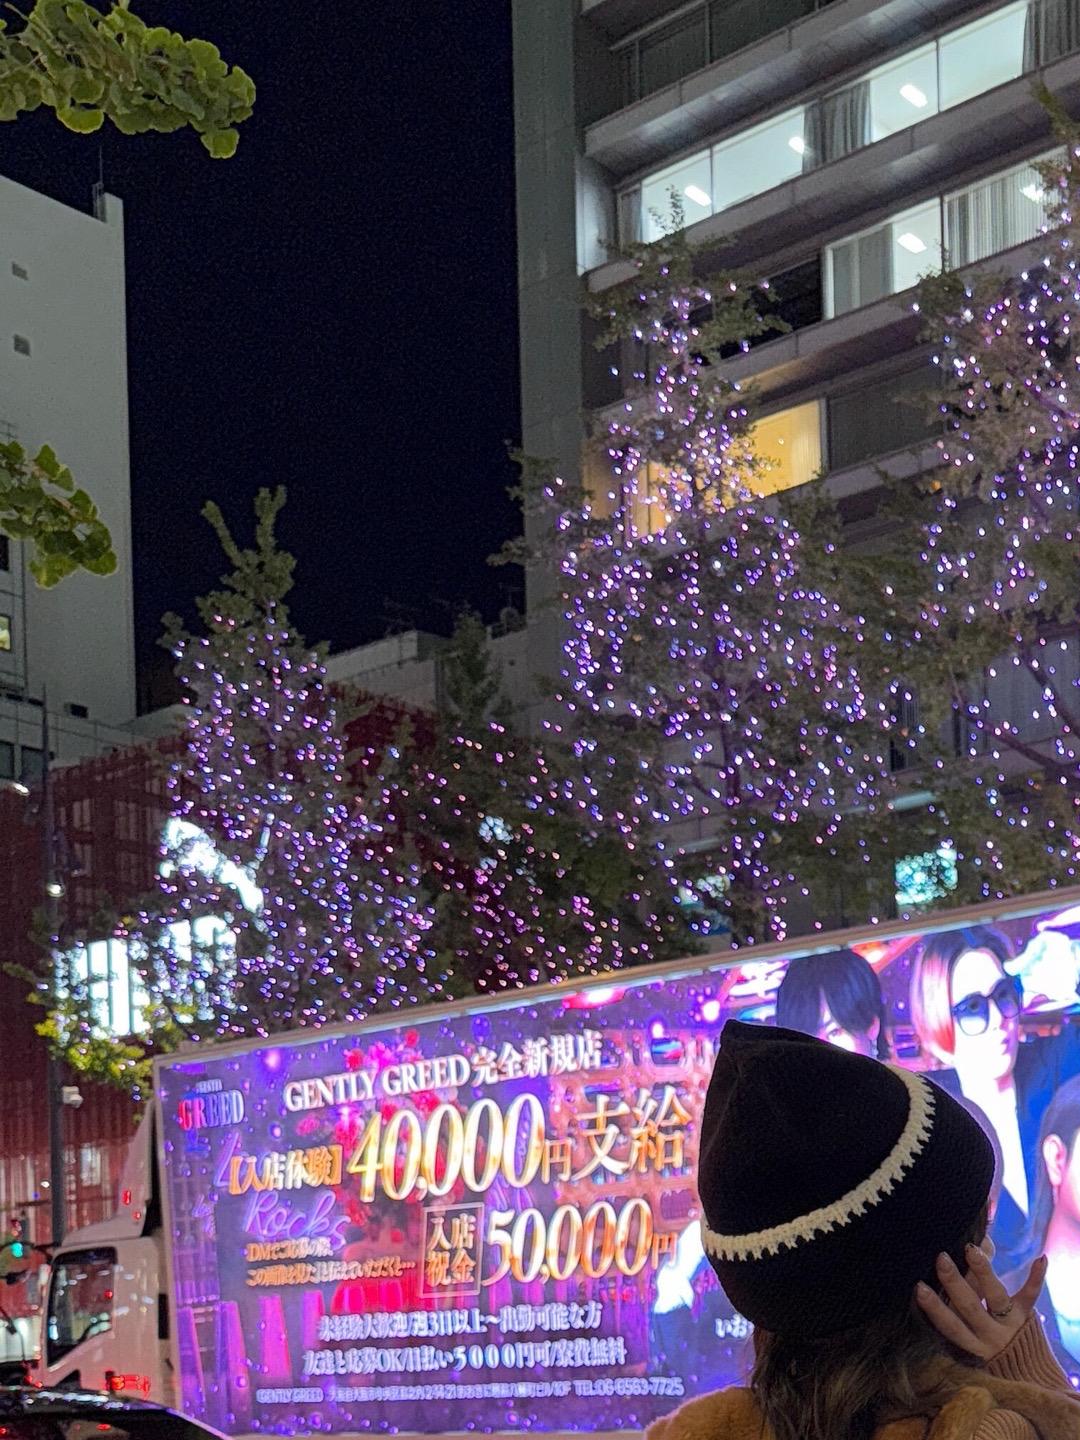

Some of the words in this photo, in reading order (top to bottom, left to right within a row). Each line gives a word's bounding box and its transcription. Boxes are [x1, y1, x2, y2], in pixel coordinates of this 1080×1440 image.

[284, 1071, 377, 1113] GENTLY
[382, 1053, 471, 1098] GREED
[472, 1029, 604, 1087] 完全新規店
[178, 1089, 245, 1131] GREED
[243, 1190, 351, 1249] Rocks
[426, 1213, 476, 1252] 入店
[481, 1198, 679, 1288] 50,000円
[425, 1251, 477, 1288] 祝金
